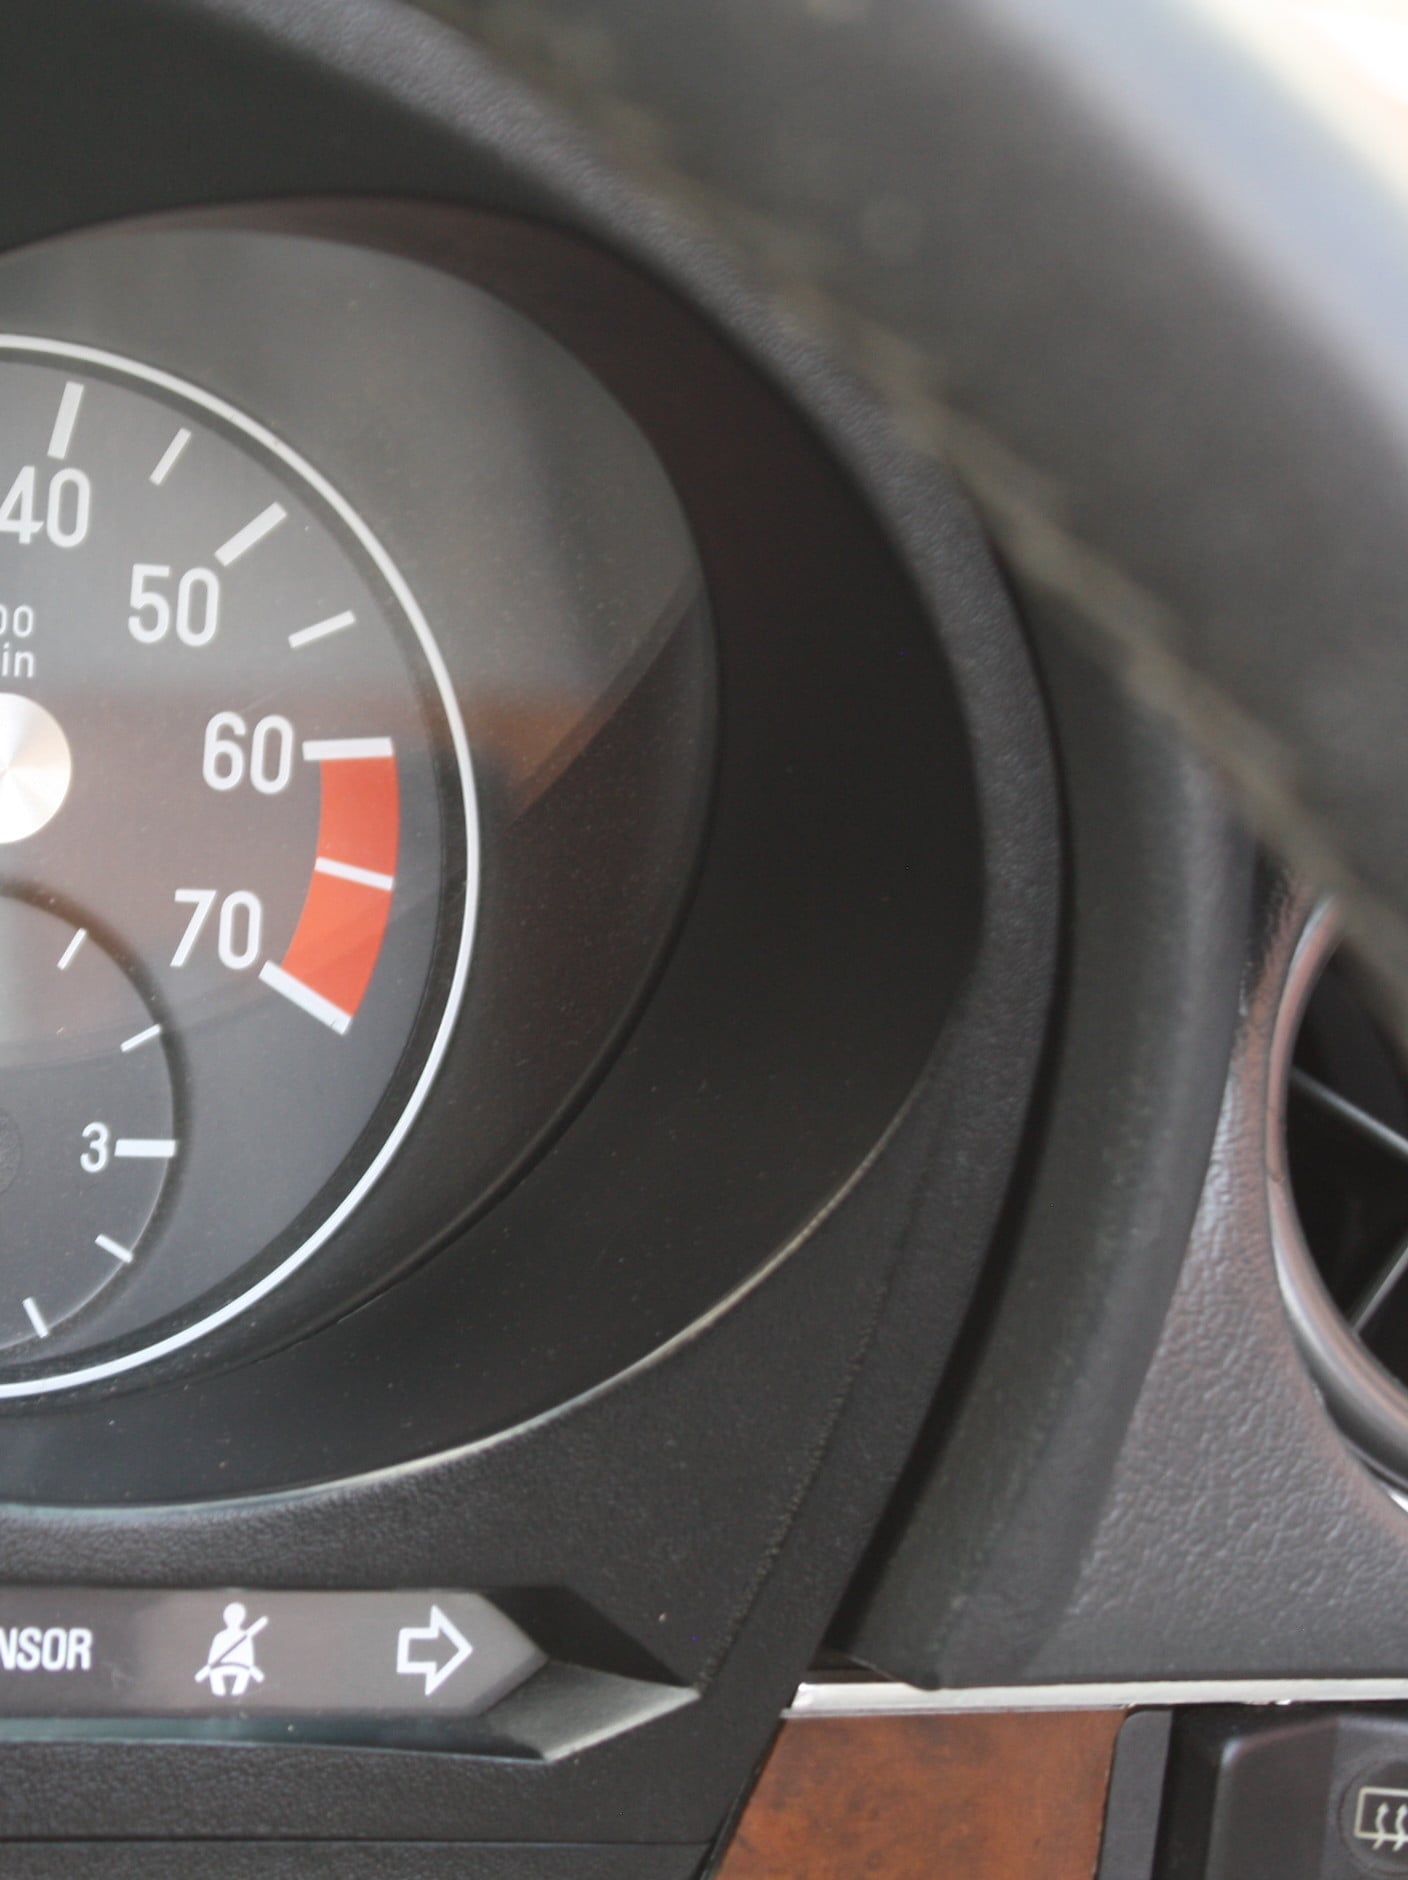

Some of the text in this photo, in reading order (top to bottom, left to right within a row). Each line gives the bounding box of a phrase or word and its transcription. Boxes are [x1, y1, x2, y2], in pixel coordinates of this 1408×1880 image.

[128, 563, 219, 646] 50
[203, 711, 293, 794] 60
[170, 889, 261, 969] 70
[80, 1122, 109, 1173] 3
